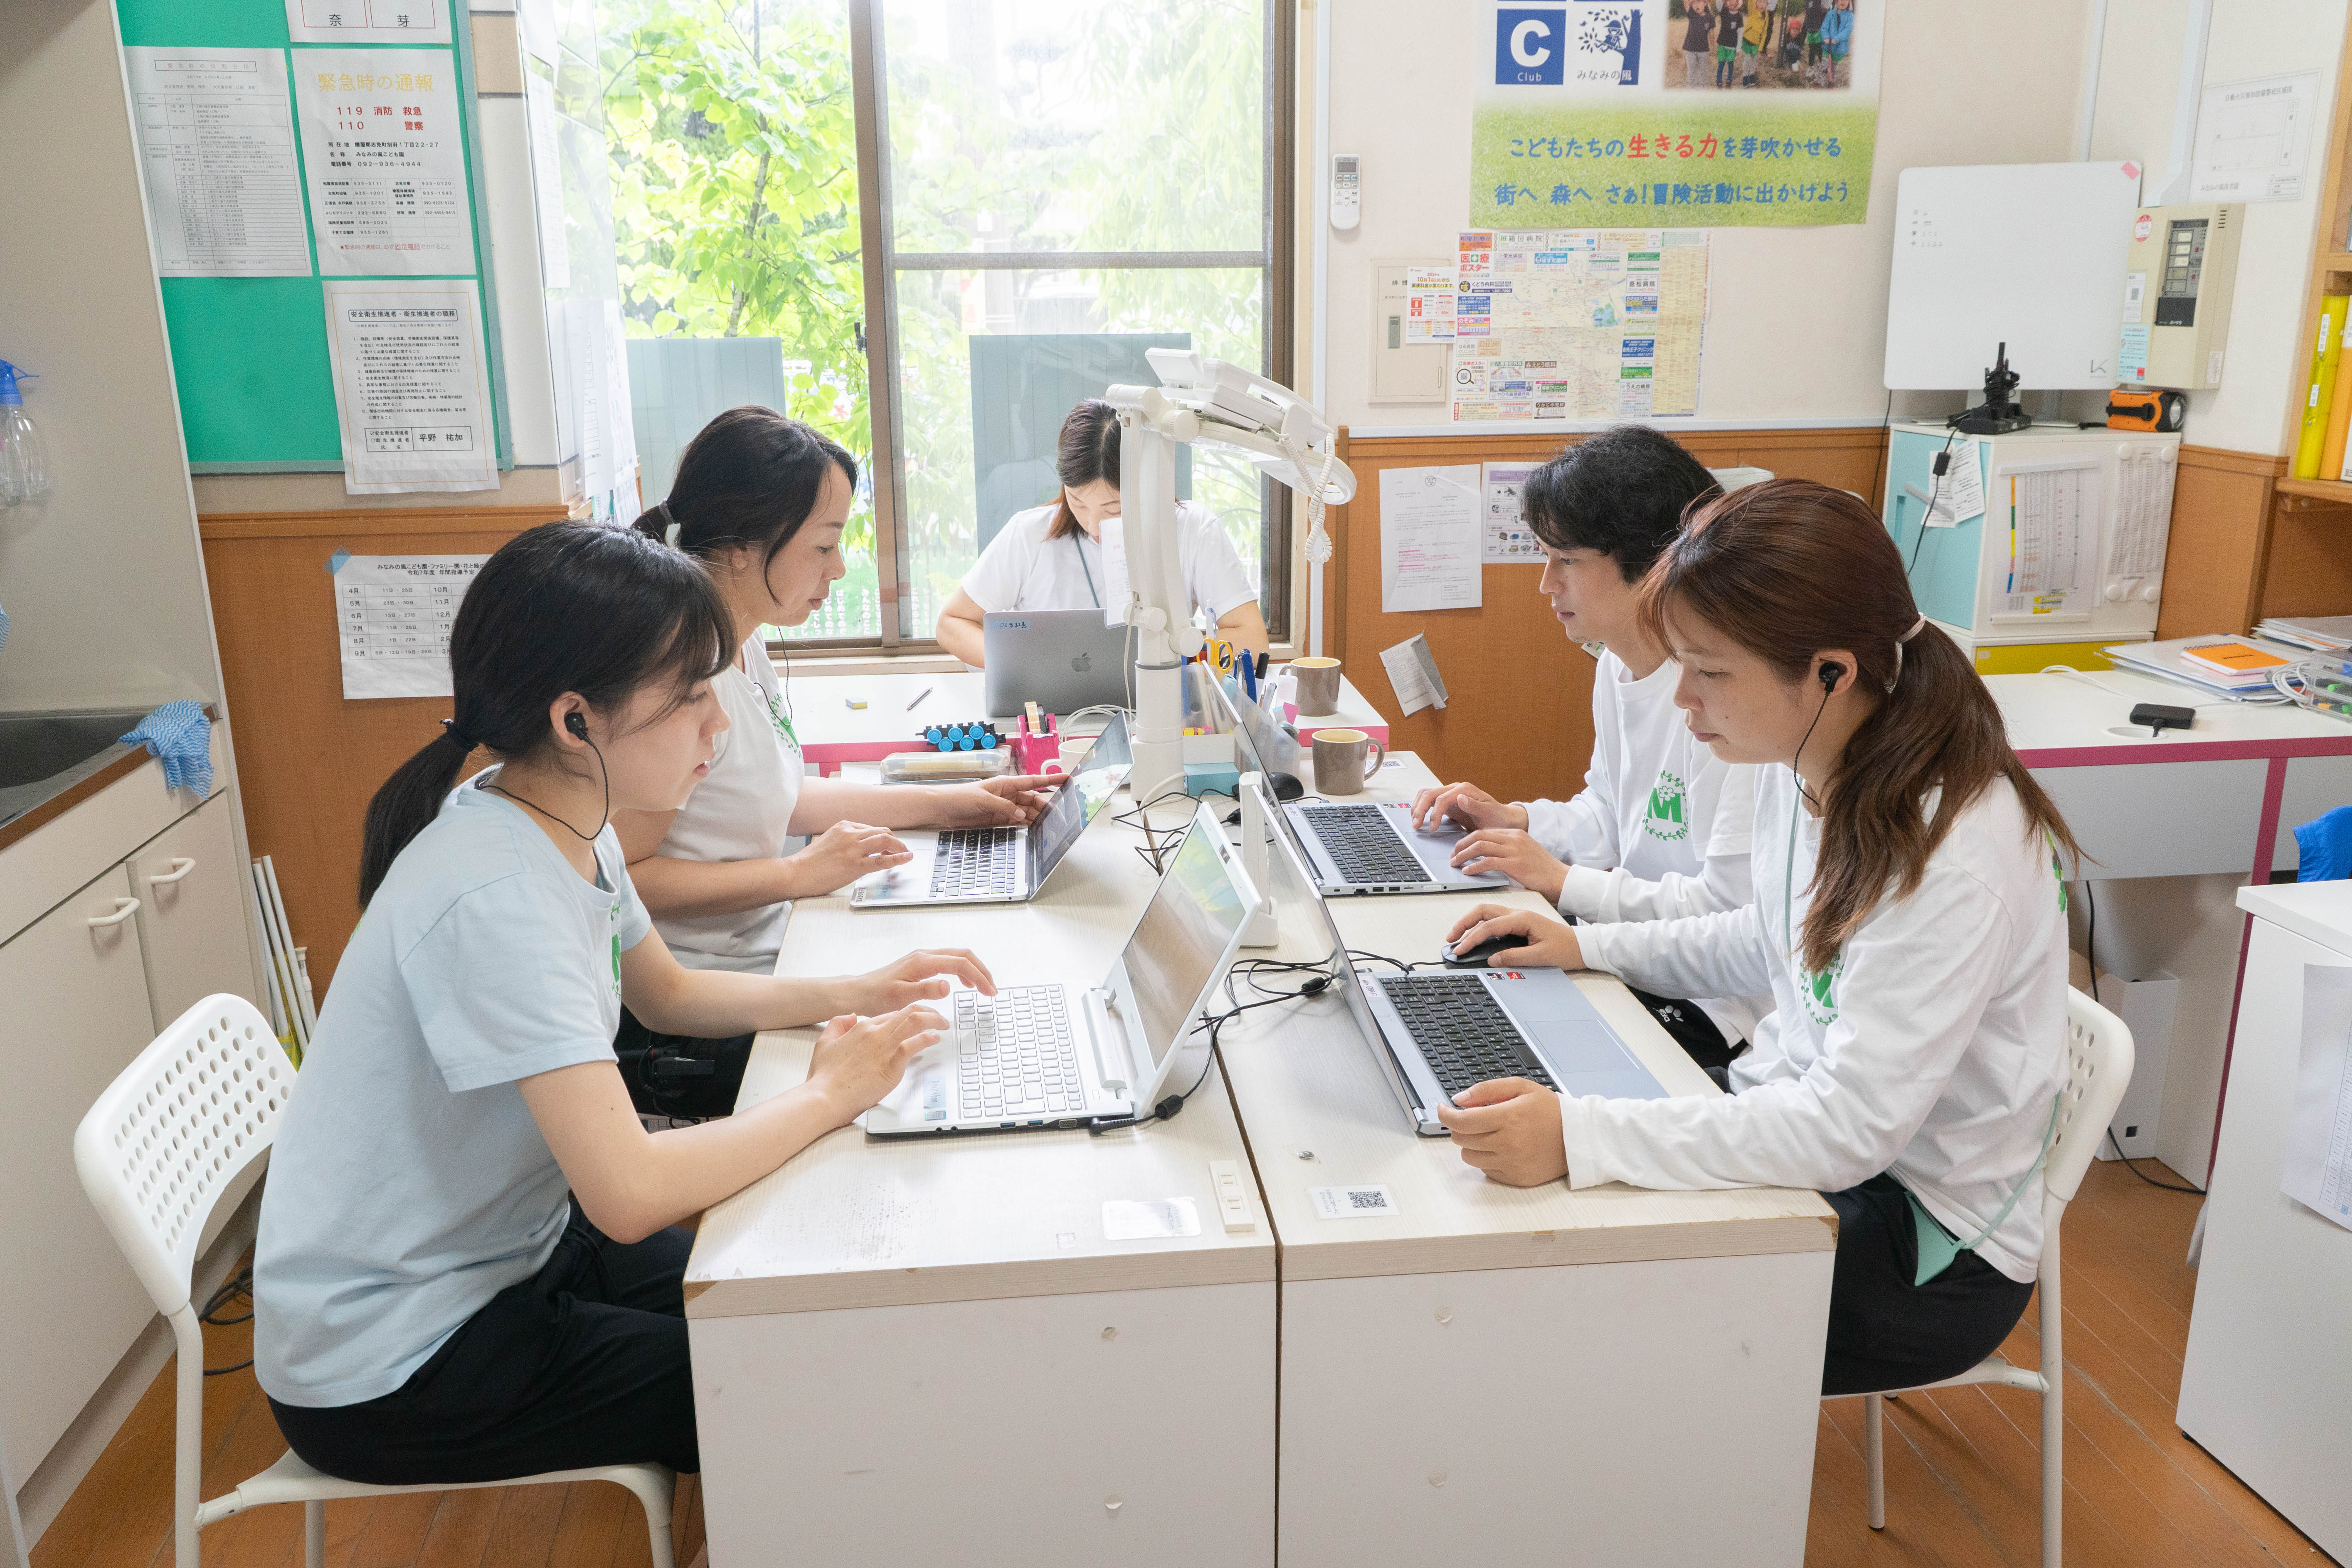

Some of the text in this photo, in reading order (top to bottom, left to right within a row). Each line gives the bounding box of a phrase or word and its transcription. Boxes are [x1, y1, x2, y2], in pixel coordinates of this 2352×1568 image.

[329, 14, 342, 26] 奈
[397, 14, 410, 27] 芽
[1510, 19, 1551, 67] C
[1517, 72, 1541, 82] Club
[1577, 70, 1632, 81] みなみの風
[318, 73, 434, 92] 緊急時の通報
[337, 107, 422, 116] 119 消防 救急
[339, 121, 423, 131] 110 警察
[1510, 133, 1842, 158] こどもたちの生きる力を芽吹かせる
[1495, 183, 1538, 207] 街へ
[1550, 183, 1592, 205] 森へ
[1461, 253, 1489, 263] 医療
[1647, 787, 1682, 823] M
